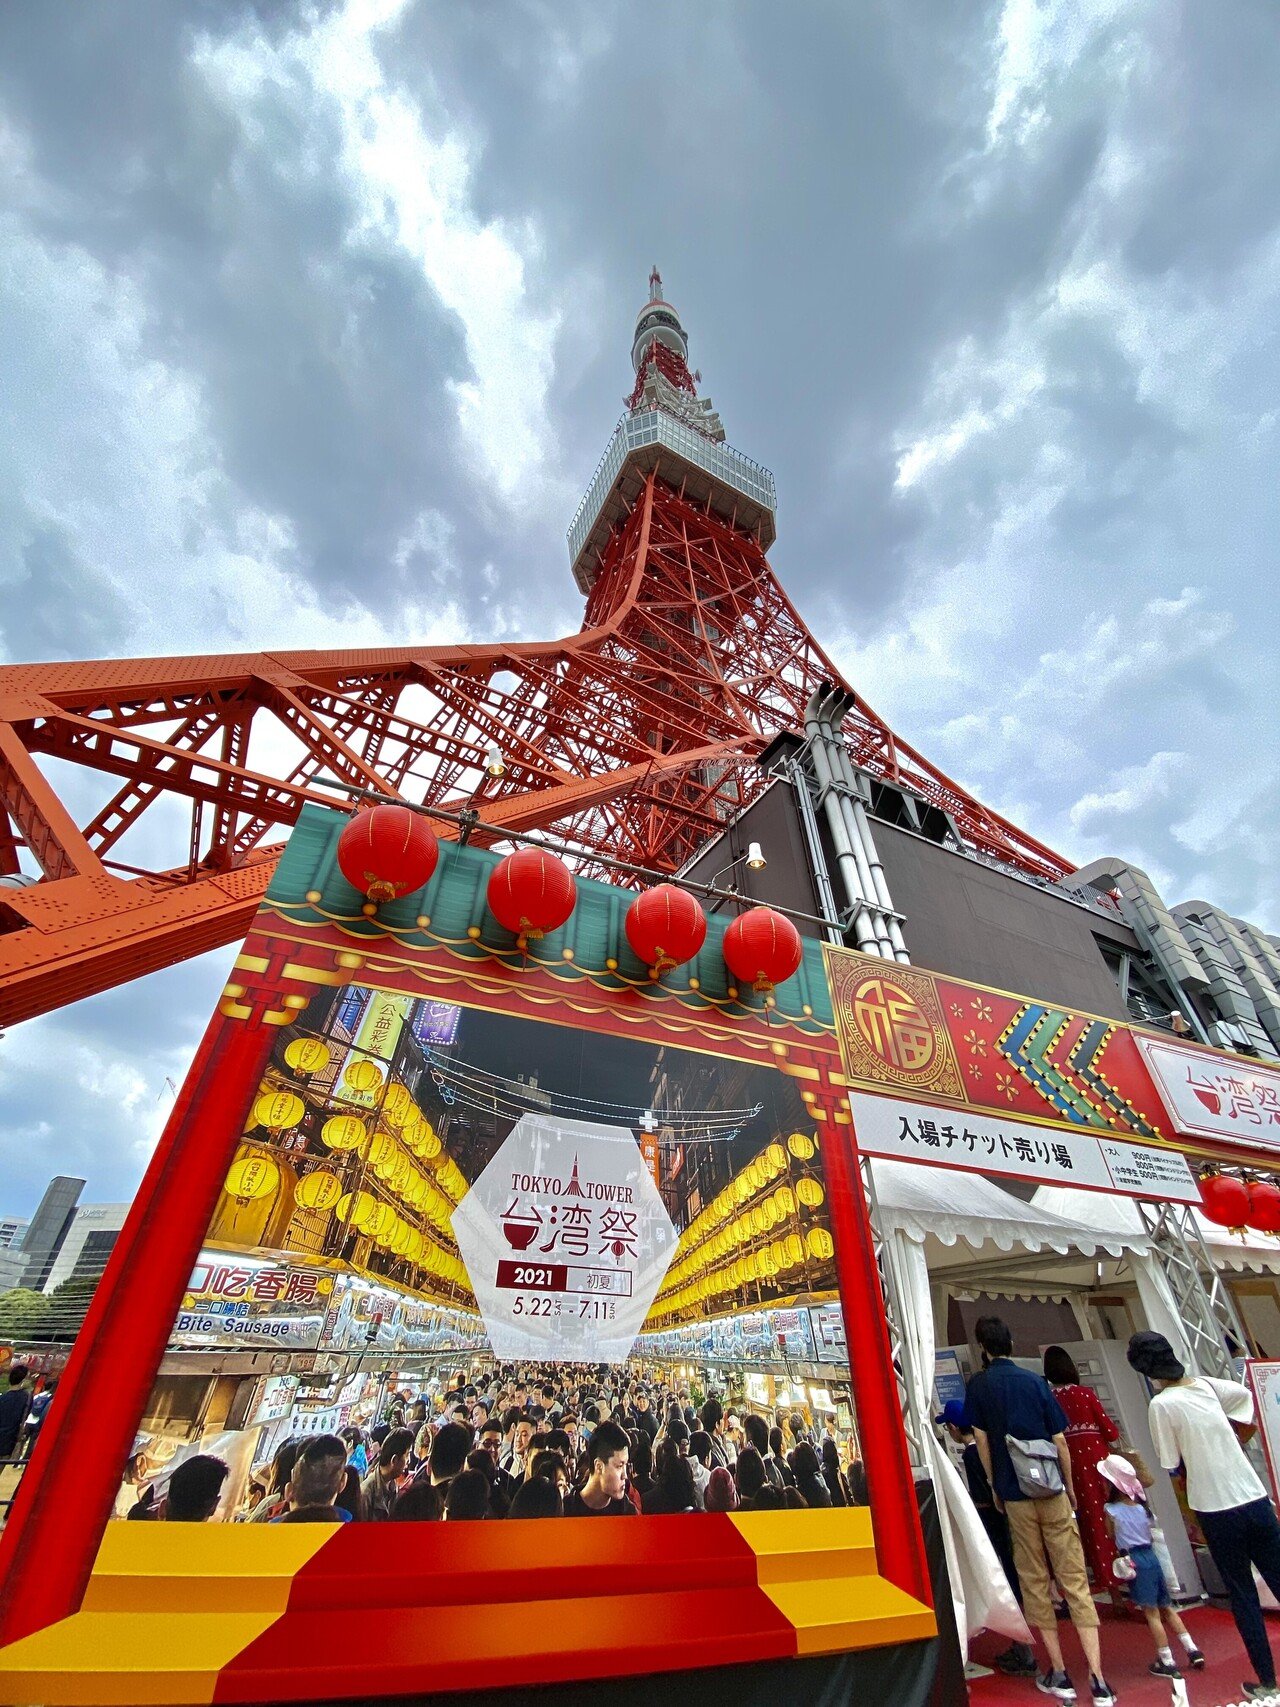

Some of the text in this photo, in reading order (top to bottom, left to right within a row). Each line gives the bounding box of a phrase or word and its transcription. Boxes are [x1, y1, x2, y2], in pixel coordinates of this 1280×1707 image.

[855, 979, 933, 1070] 福
[897, 1115, 1074, 1170] 入場チケット売り場
[1131, 1151, 1151, 1163] 900円
[1135, 1160, 1155, 1172] 800円
[1139, 1169, 1159, 1181] 500円
[511, 1173, 634, 1203] TOKYO TOWER
[499, 1197, 639, 1266] 台湾祭
[186, 1262, 319, 1304] 口吃香腸
[513, 1267, 612, 1290] 2021 初夏
[512, 1296, 552, 1317] 5.22
[554, 1299, 562, 1315] SAT
[579, 1300, 609, 1320] 7.11
[223, 1317, 290, 1337] Sausage
